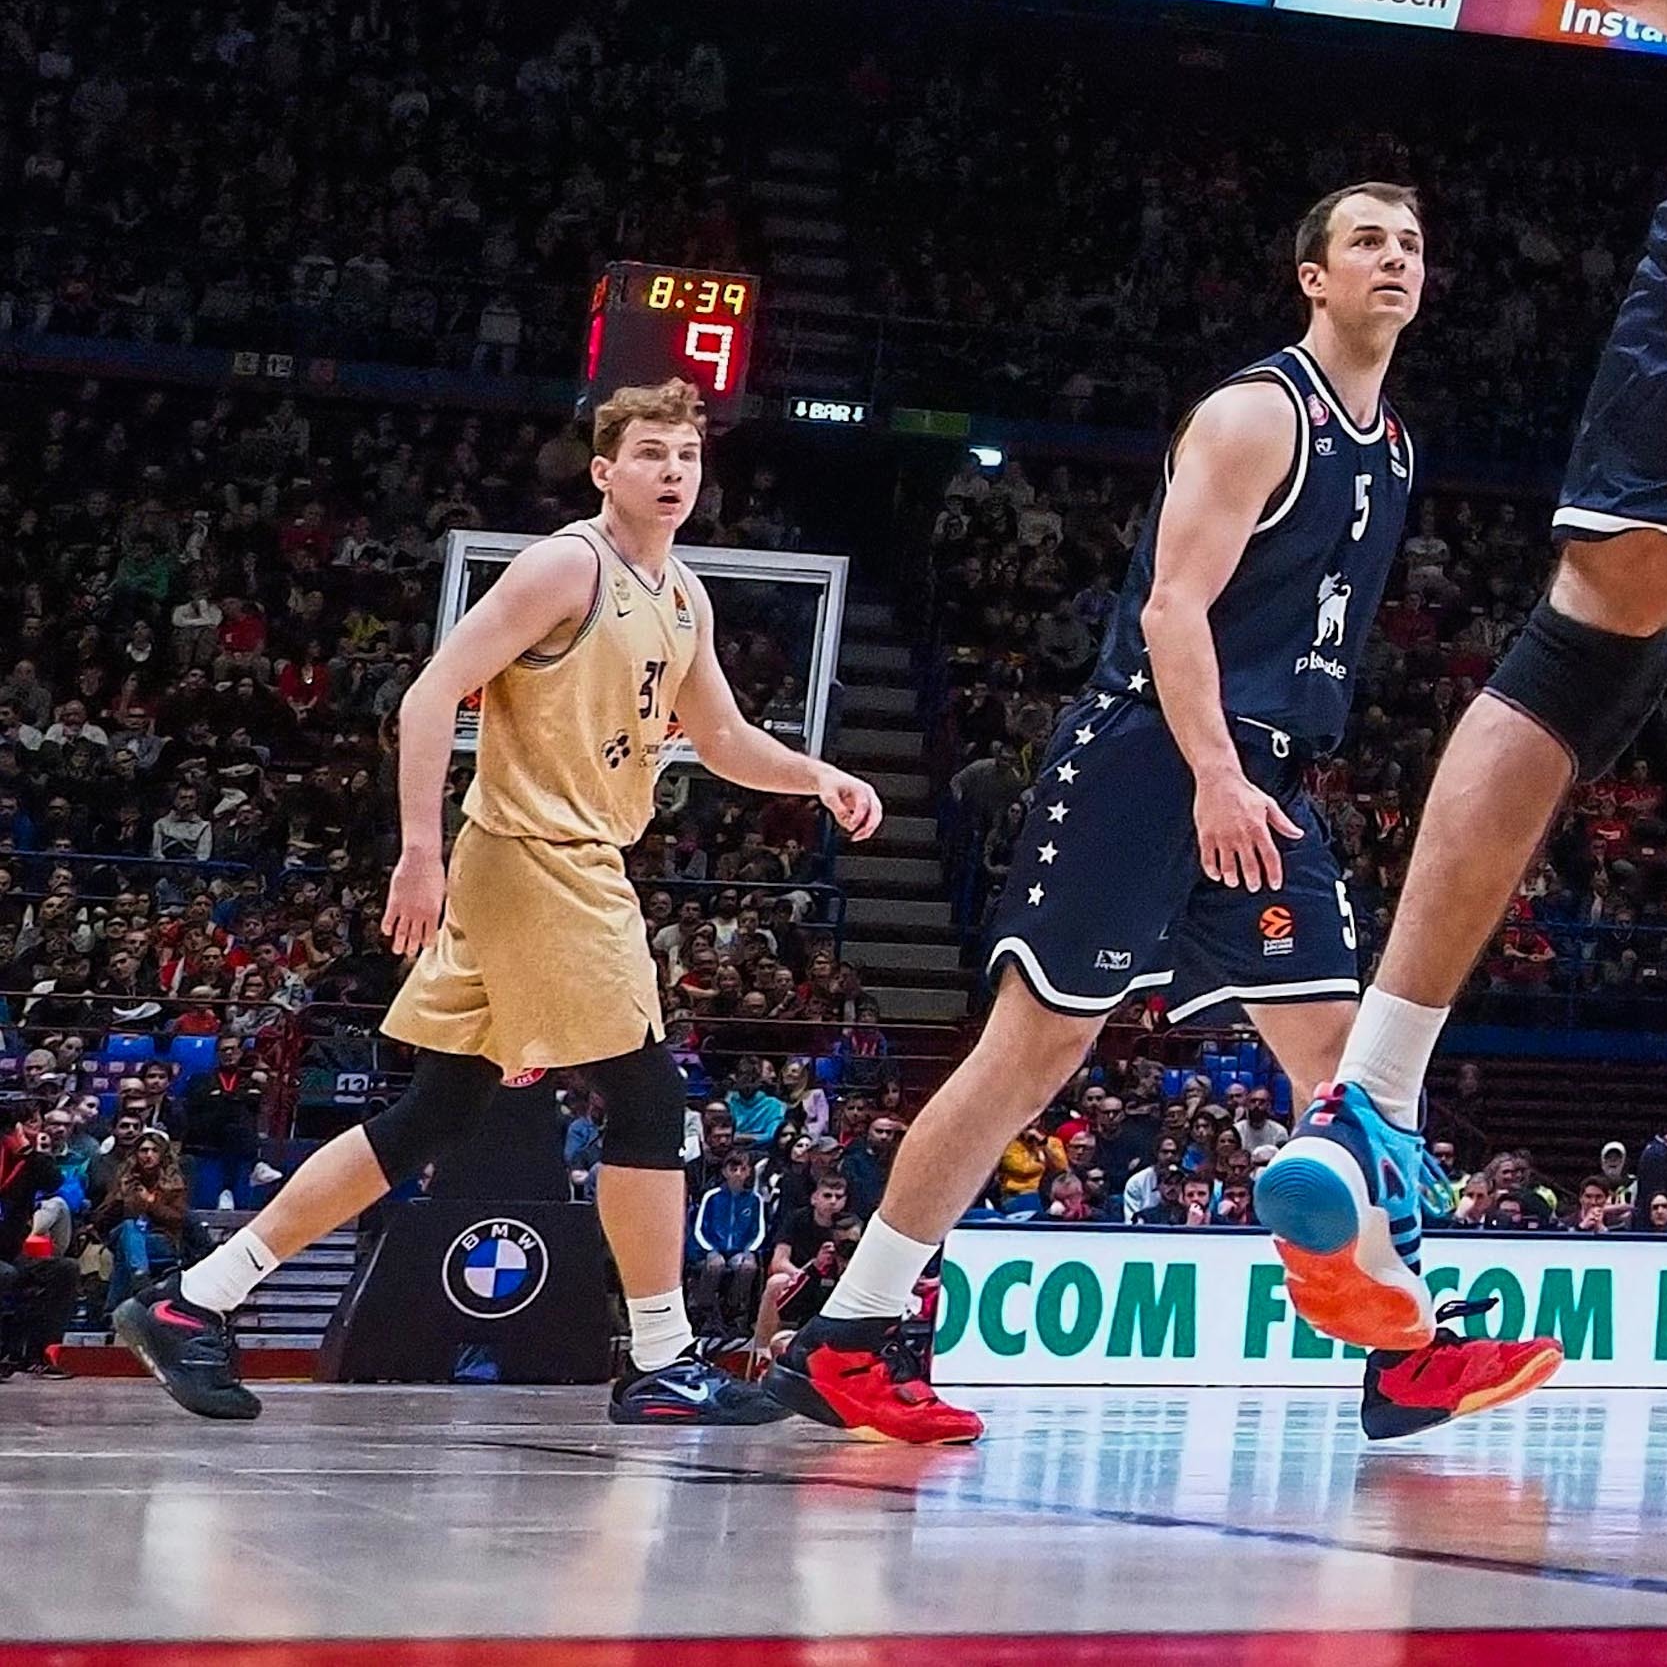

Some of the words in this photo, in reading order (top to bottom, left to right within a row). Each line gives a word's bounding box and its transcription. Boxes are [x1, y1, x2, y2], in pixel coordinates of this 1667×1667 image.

[648, 276, 746, 315] 8:39
[684, 321, 734, 391] 9
[808, 402, 852, 422] BAR
[1350, 472, 1373, 542] 5
[638, 660, 668, 720] 31
[1334, 879, 1357, 950] 5
[461, 1223, 537, 1251] BMW
[1242, 1263, 1614, 1361] FOM
